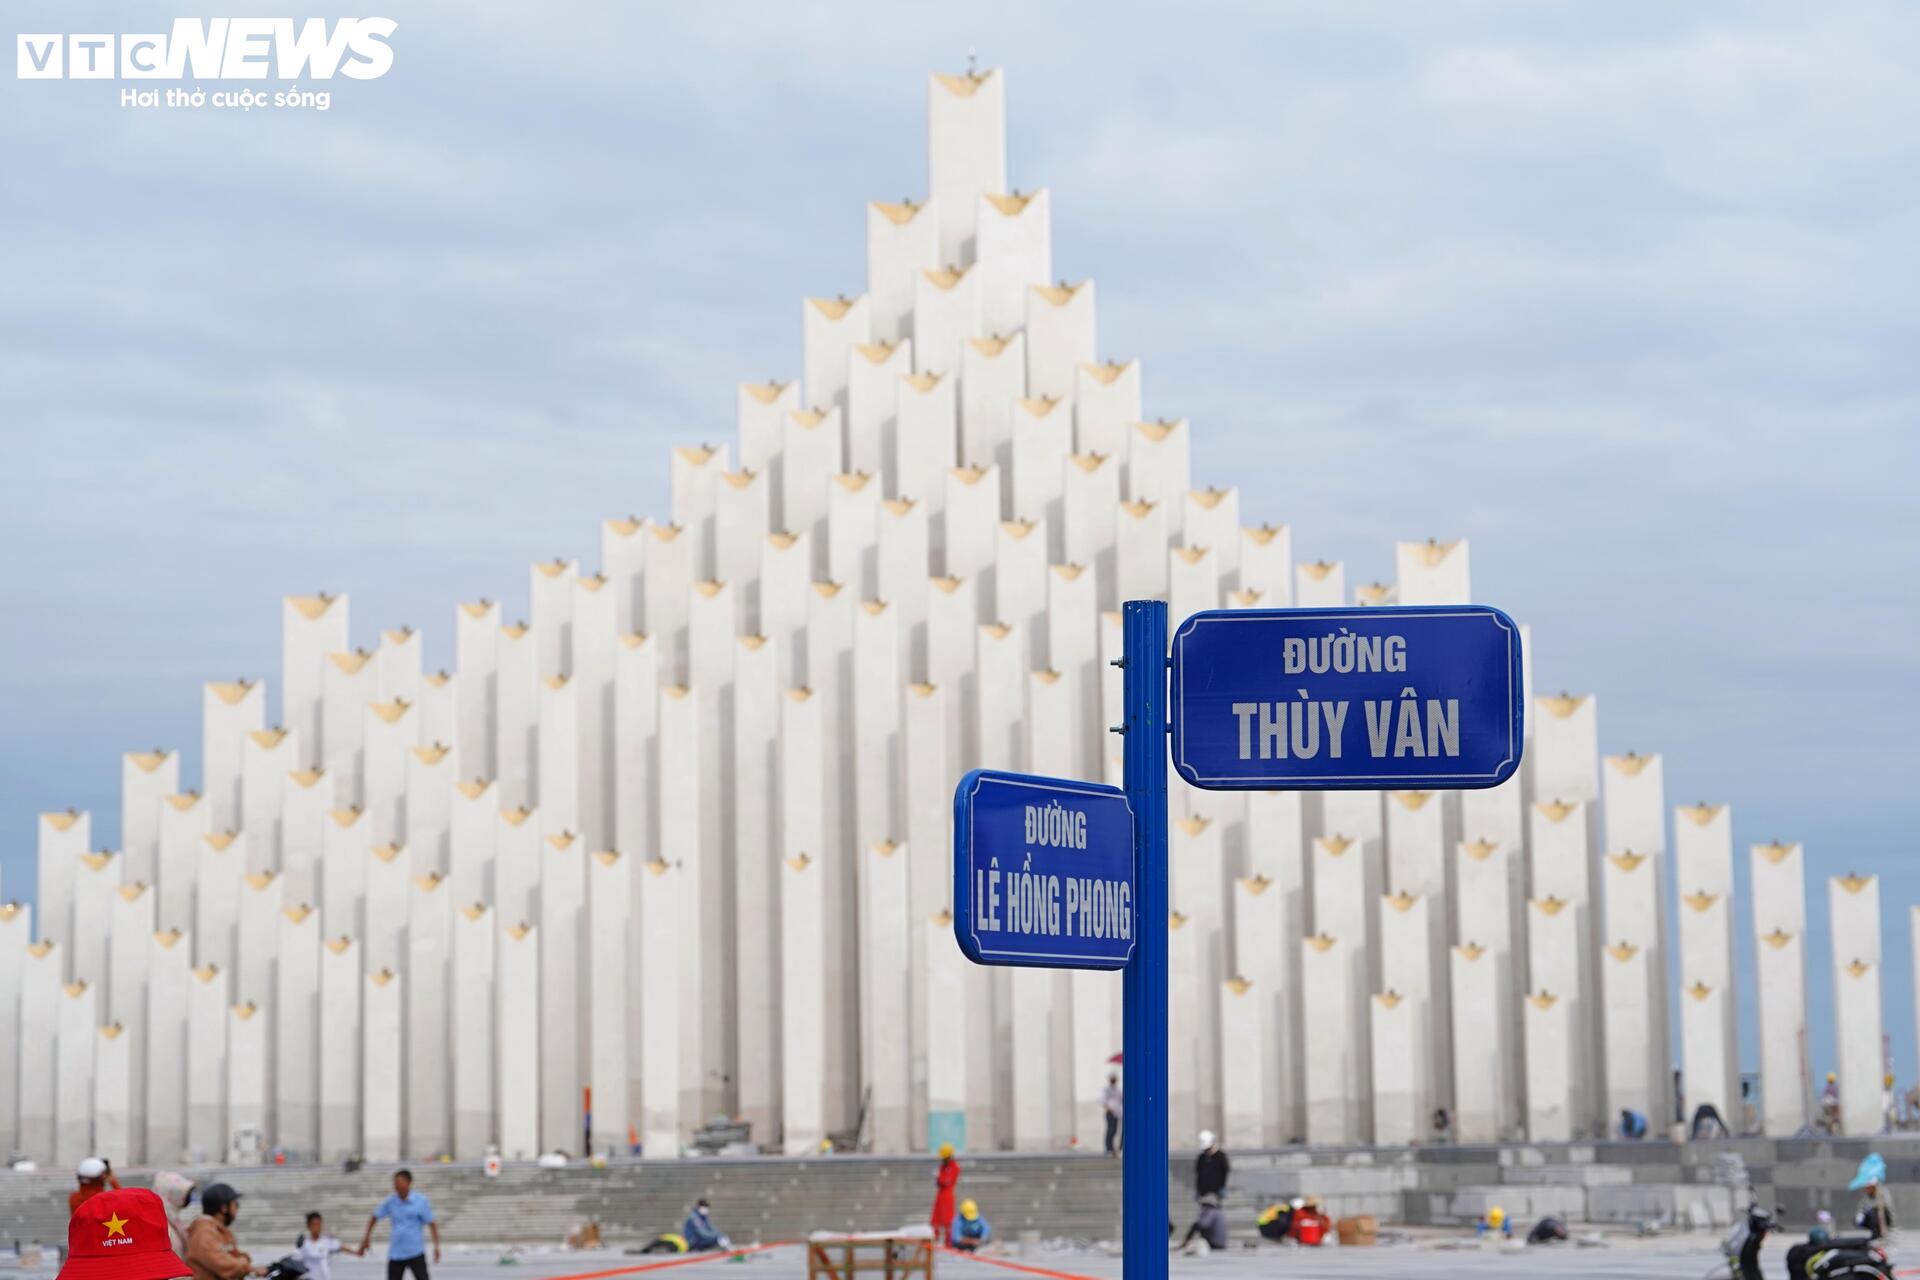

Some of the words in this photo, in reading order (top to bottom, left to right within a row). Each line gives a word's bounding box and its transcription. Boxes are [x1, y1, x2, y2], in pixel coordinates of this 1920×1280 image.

[1283, 627, 1407, 674] ĐƯỜNG
[1232, 689, 1350, 760] THÙY
[1364, 687, 1460, 758] VÂN
[1025, 799, 1087, 849] ĐƯỜNG
[977, 856, 1001, 932] LÊ
[1007, 852, 1060, 936] HỒNG
[1066, 877, 1131, 940] PHONG
[102, 1239, 116, 1247] VIỆT
